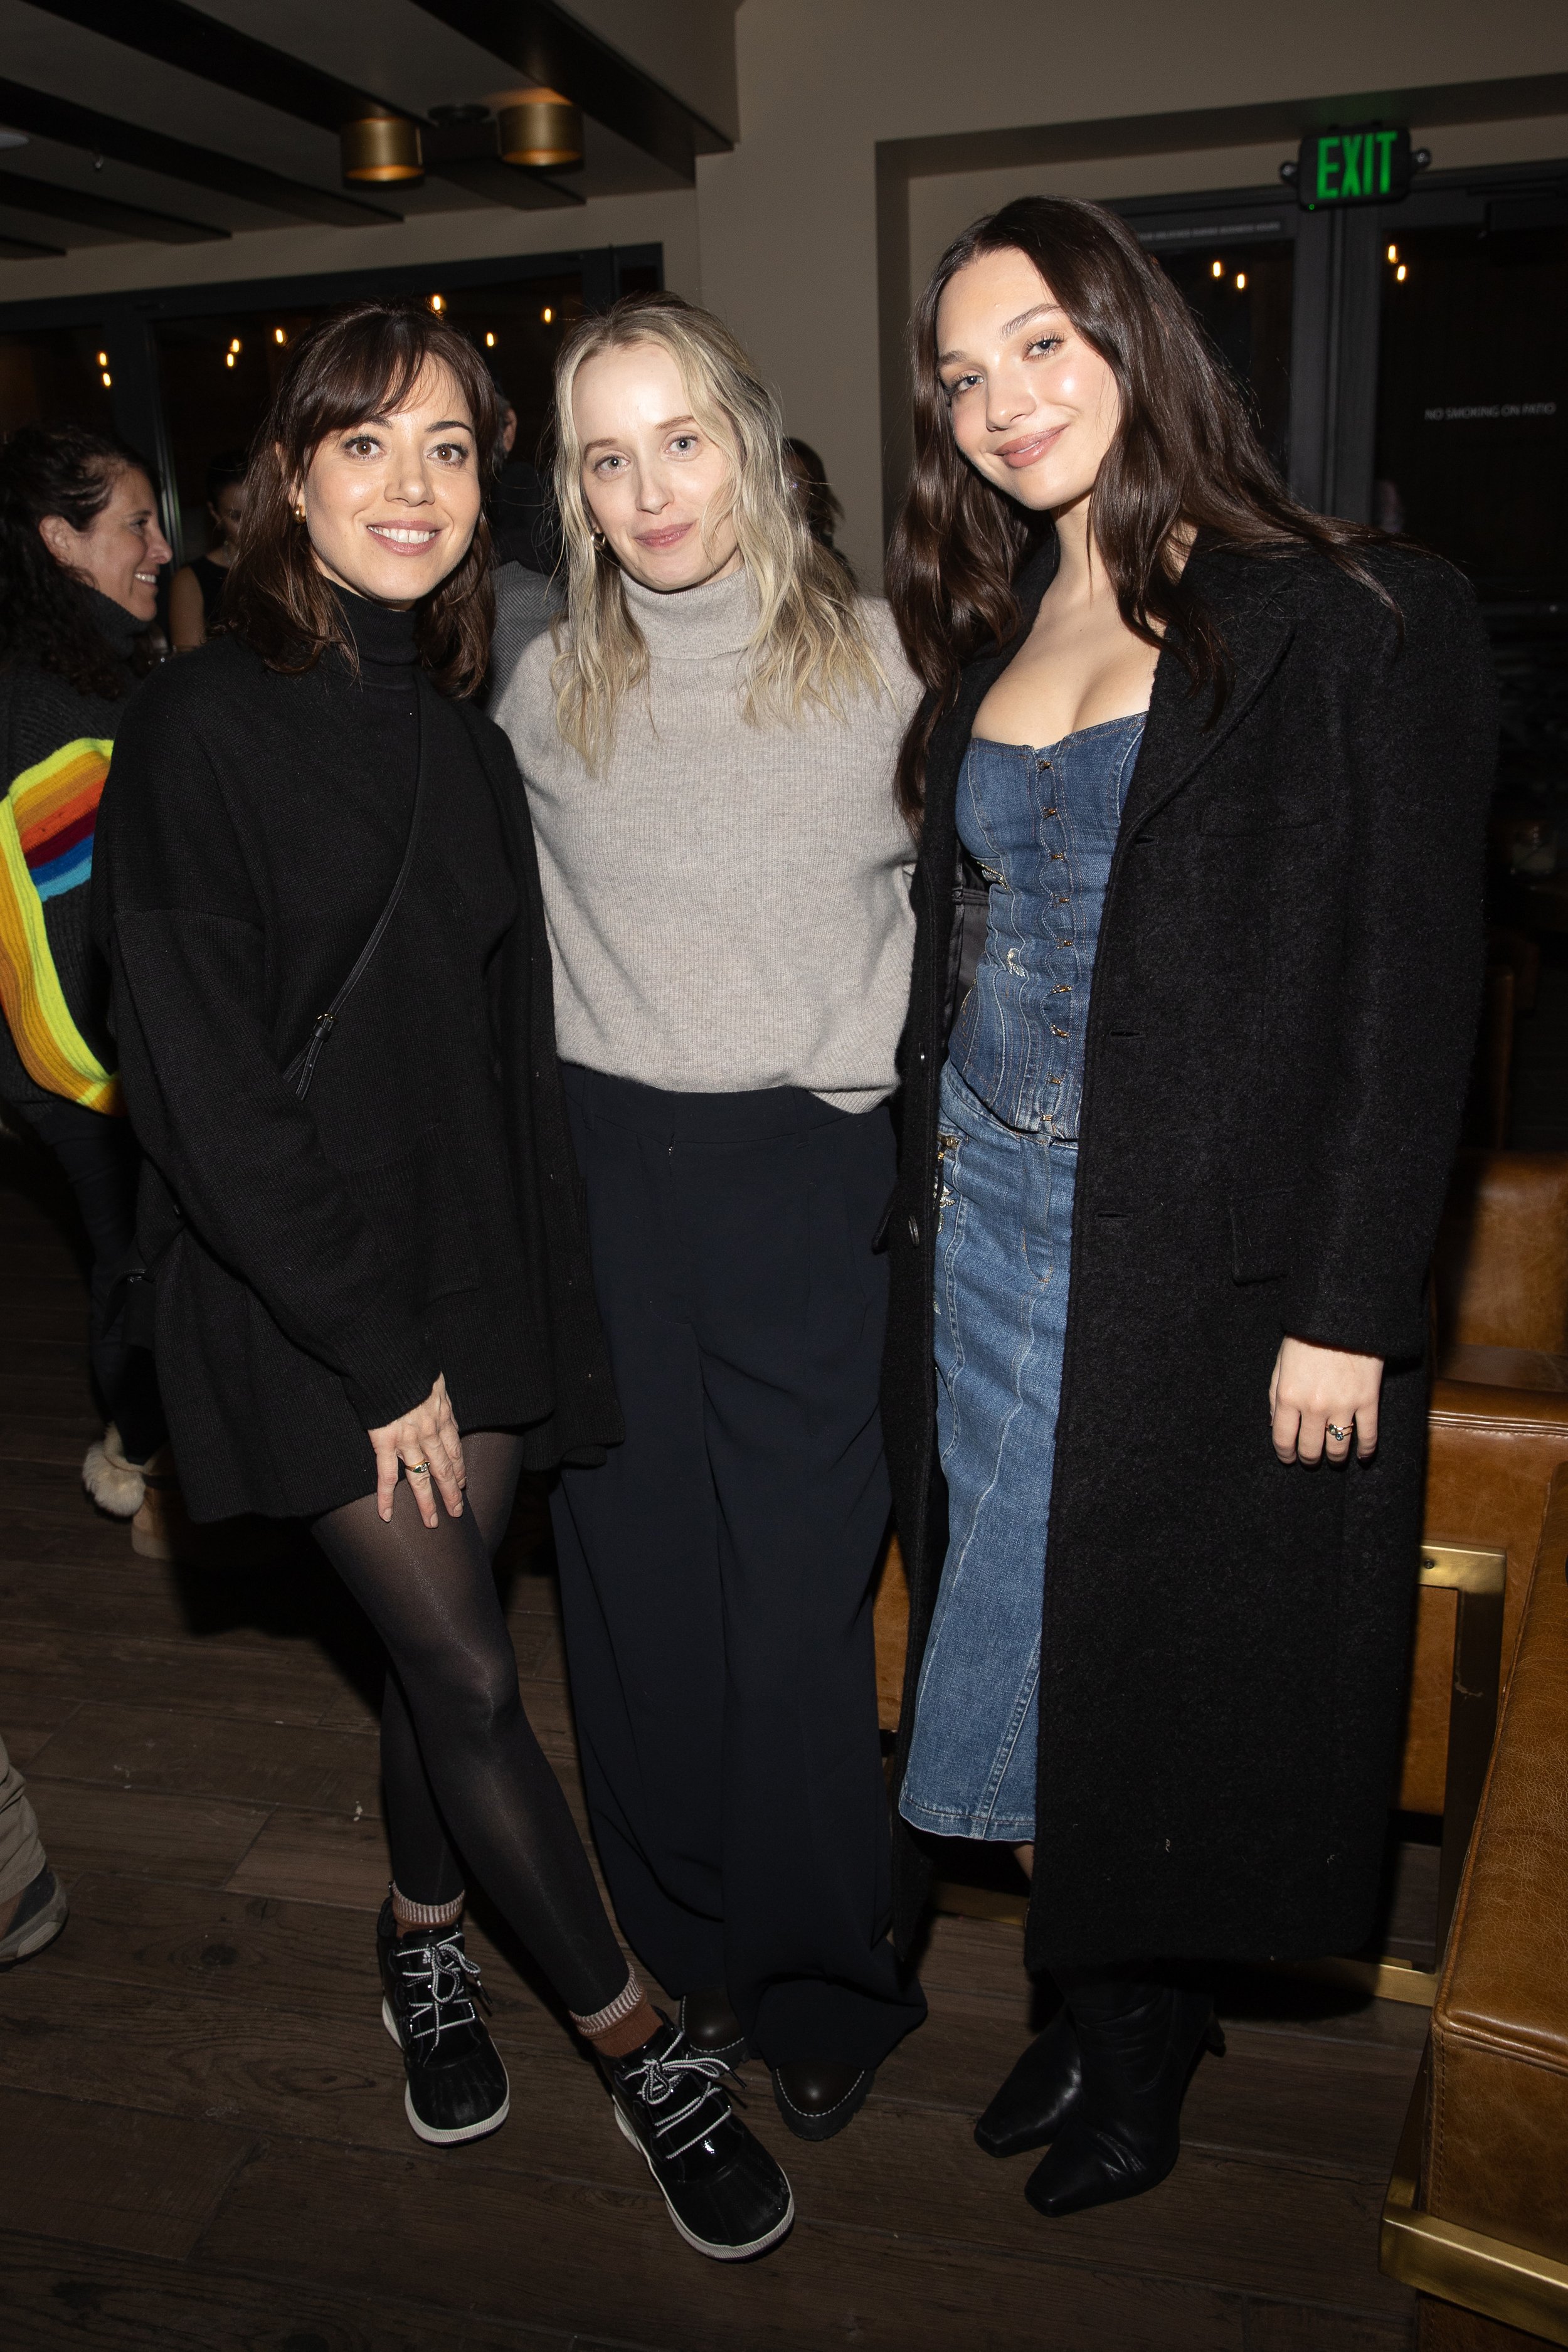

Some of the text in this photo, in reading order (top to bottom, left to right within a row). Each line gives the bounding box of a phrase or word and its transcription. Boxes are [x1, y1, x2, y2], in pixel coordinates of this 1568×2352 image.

[1318, 130, 1398, 200] EXIT
[1424, 408, 1444, 421] NO
[1445, 405, 1500, 420] SMOKING
[1501, 404, 1520, 418] ON
